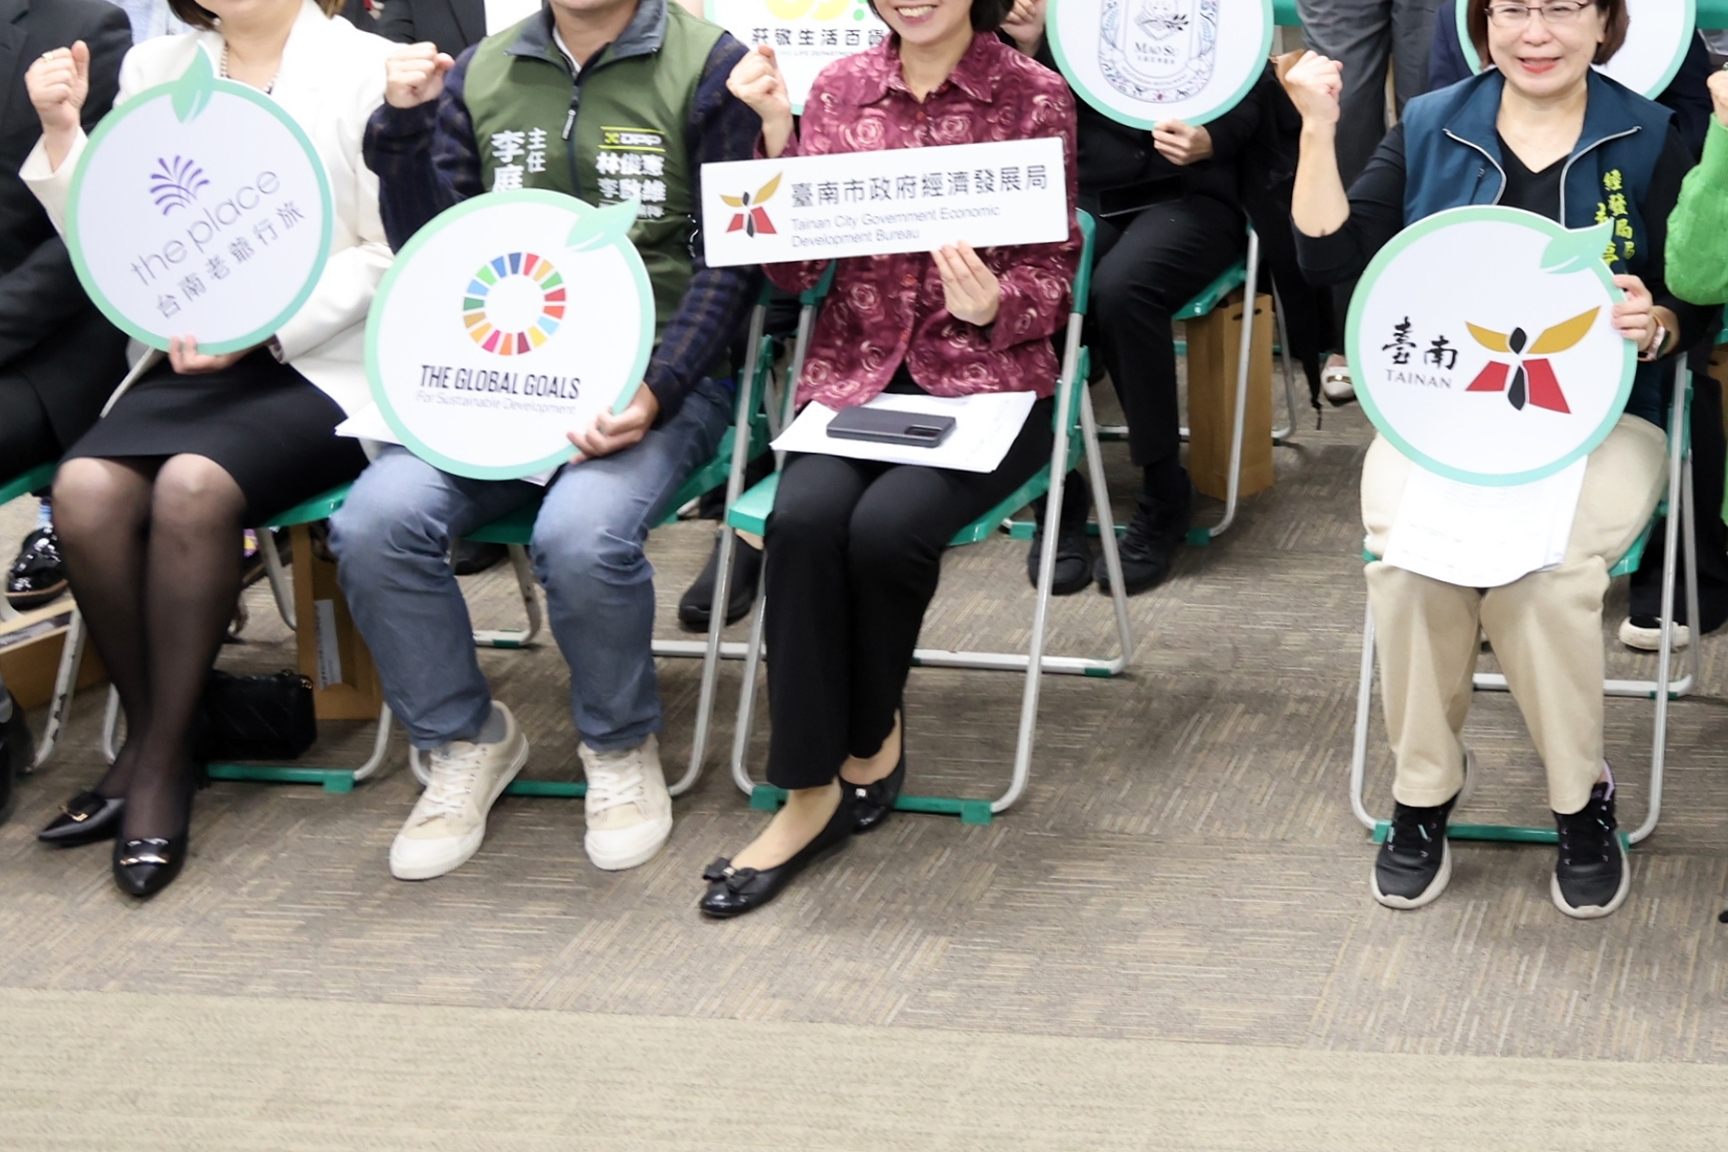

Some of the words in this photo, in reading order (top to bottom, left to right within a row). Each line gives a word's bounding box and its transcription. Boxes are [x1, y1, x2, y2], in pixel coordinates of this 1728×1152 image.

[526, 126, 548, 174] 主任
[790, 164, 1049, 209] 臺南市政府經濟發展局
[131, 240, 188, 286] the
[186, 170, 281, 254] place
[790, 215, 831, 231] Tainan
[834, 212, 859, 230] City
[863, 207, 938, 227] Government
[939, 204, 1001, 221] Economic
[790, 228, 874, 248] Development
[875, 227, 920, 243] Bureau
[156, 201, 306, 319] 台南老爺行旅
[1381, 315, 1459, 370] 臺南
[420, 364, 452, 389] THE
[454, 367, 519, 395] GLOBAL
[523, 373, 581, 400] GOALS
[1384, 367, 1453, 390] TAINAN
[436, 391, 501, 410] Sustainable
[502, 397, 577, 416] Development
